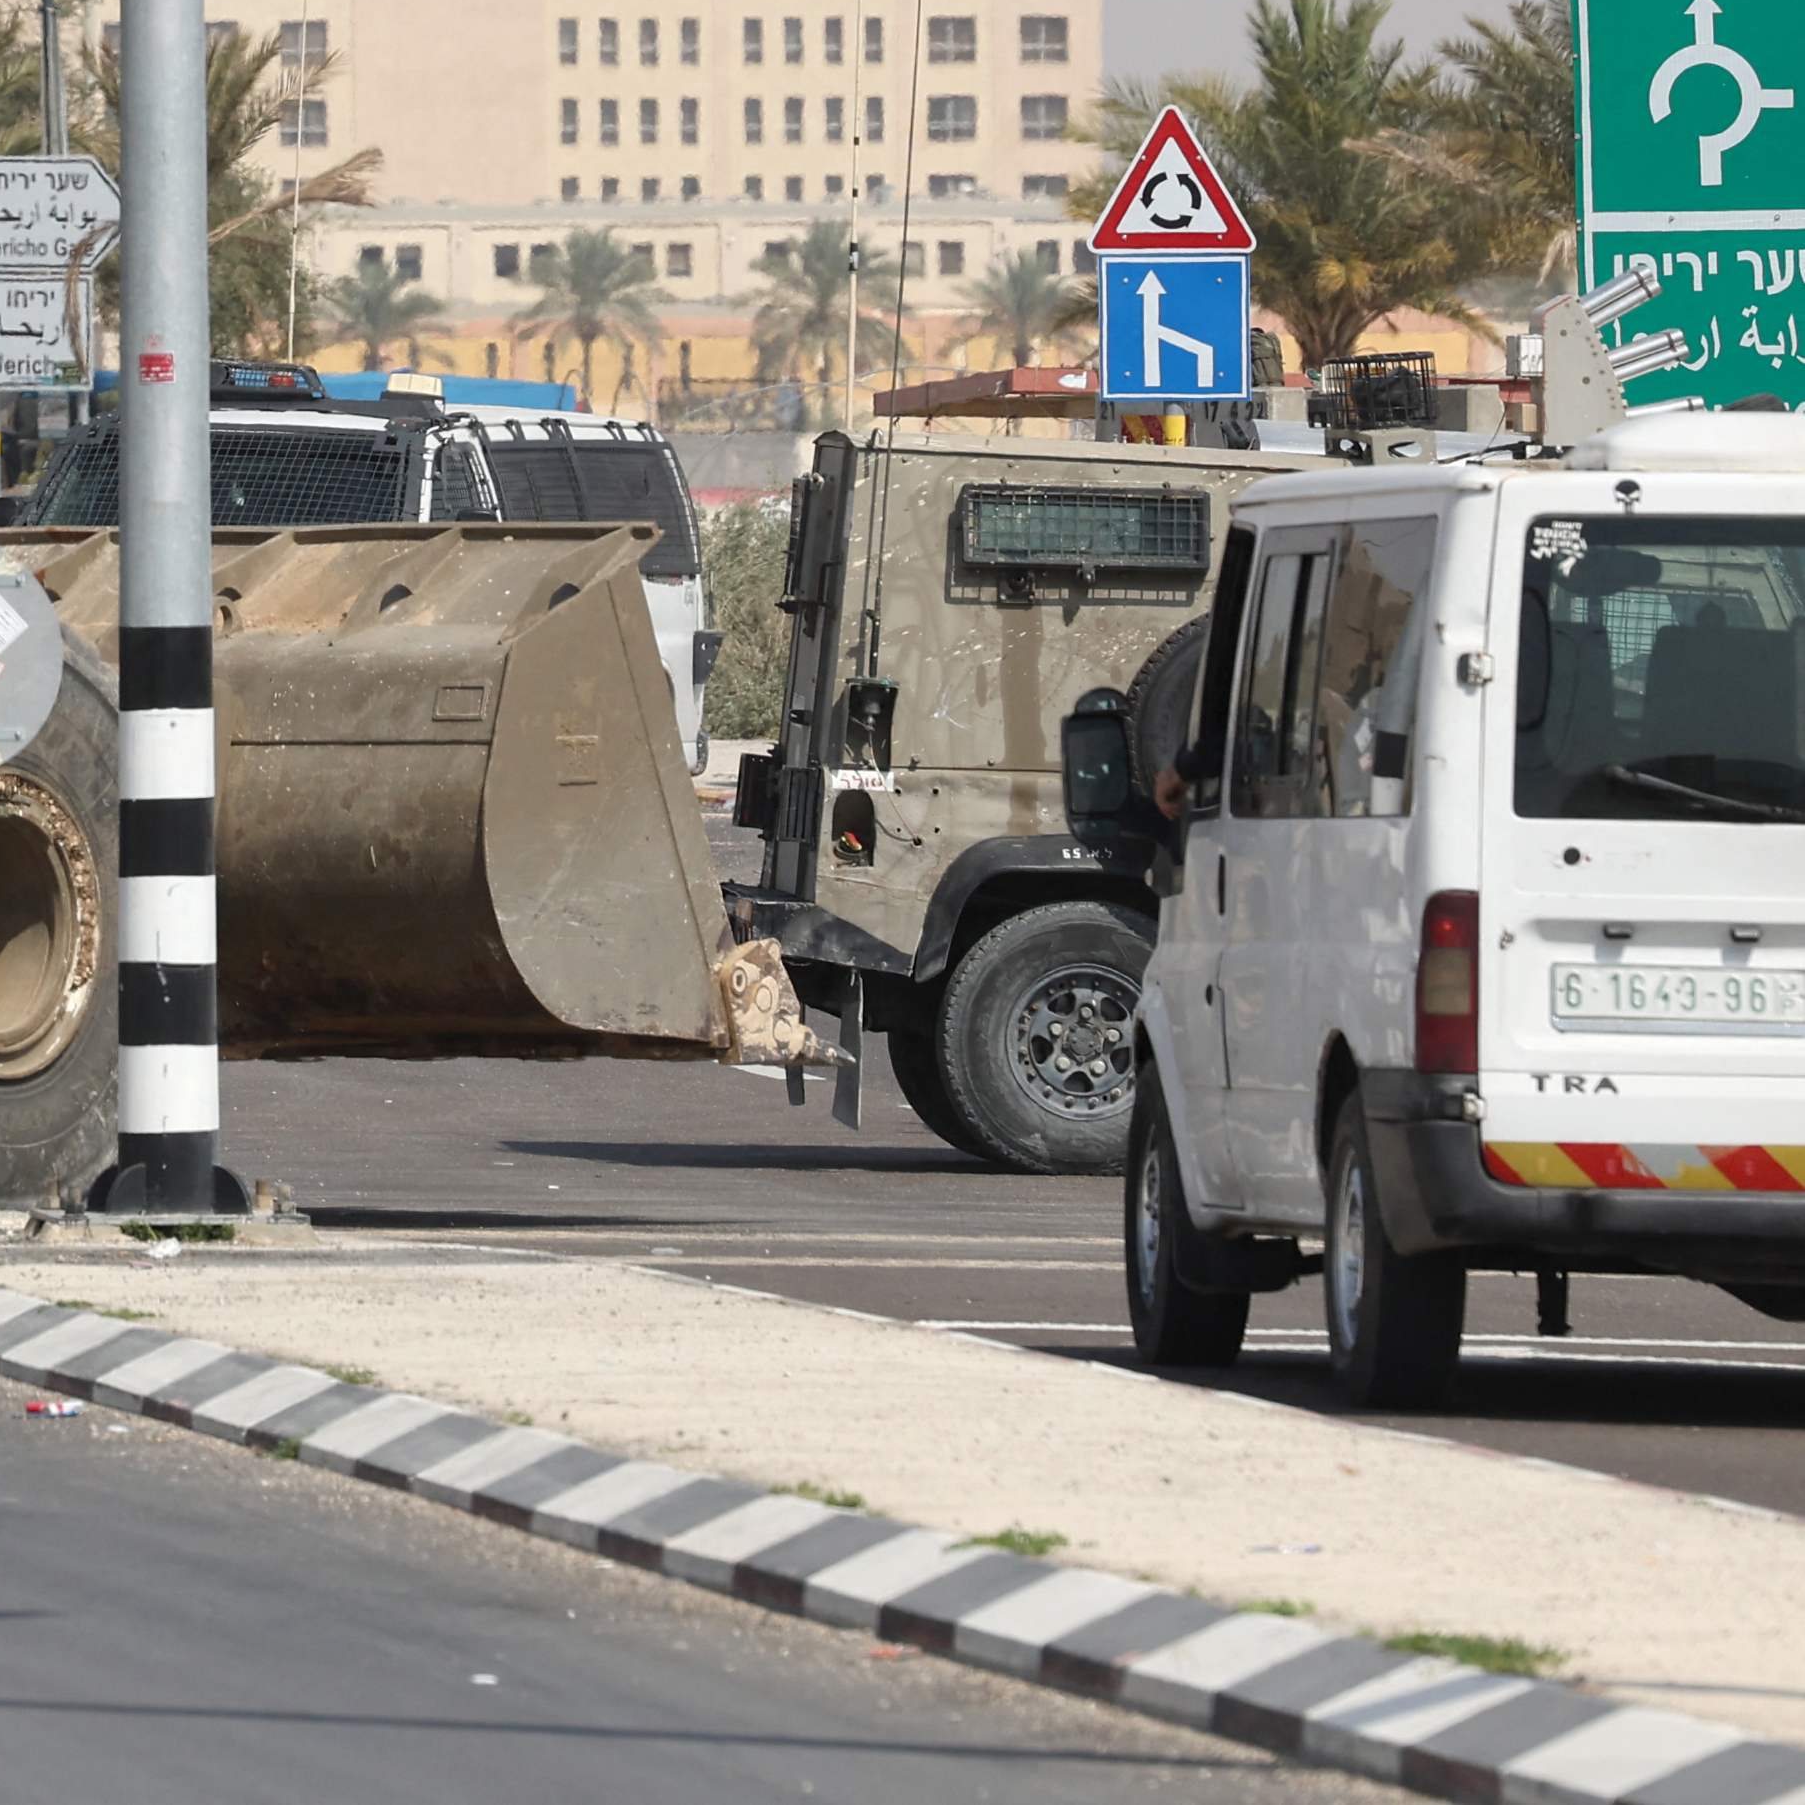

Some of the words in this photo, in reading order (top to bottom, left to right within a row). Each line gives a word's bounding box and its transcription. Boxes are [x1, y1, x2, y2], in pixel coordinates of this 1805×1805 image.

[46, 172, 89, 192] שער
[48, 196, 97, 229] بوابة
[6, 289, 55, 308] יריחו
[1531, 1074, 1619, 1095] TRA
